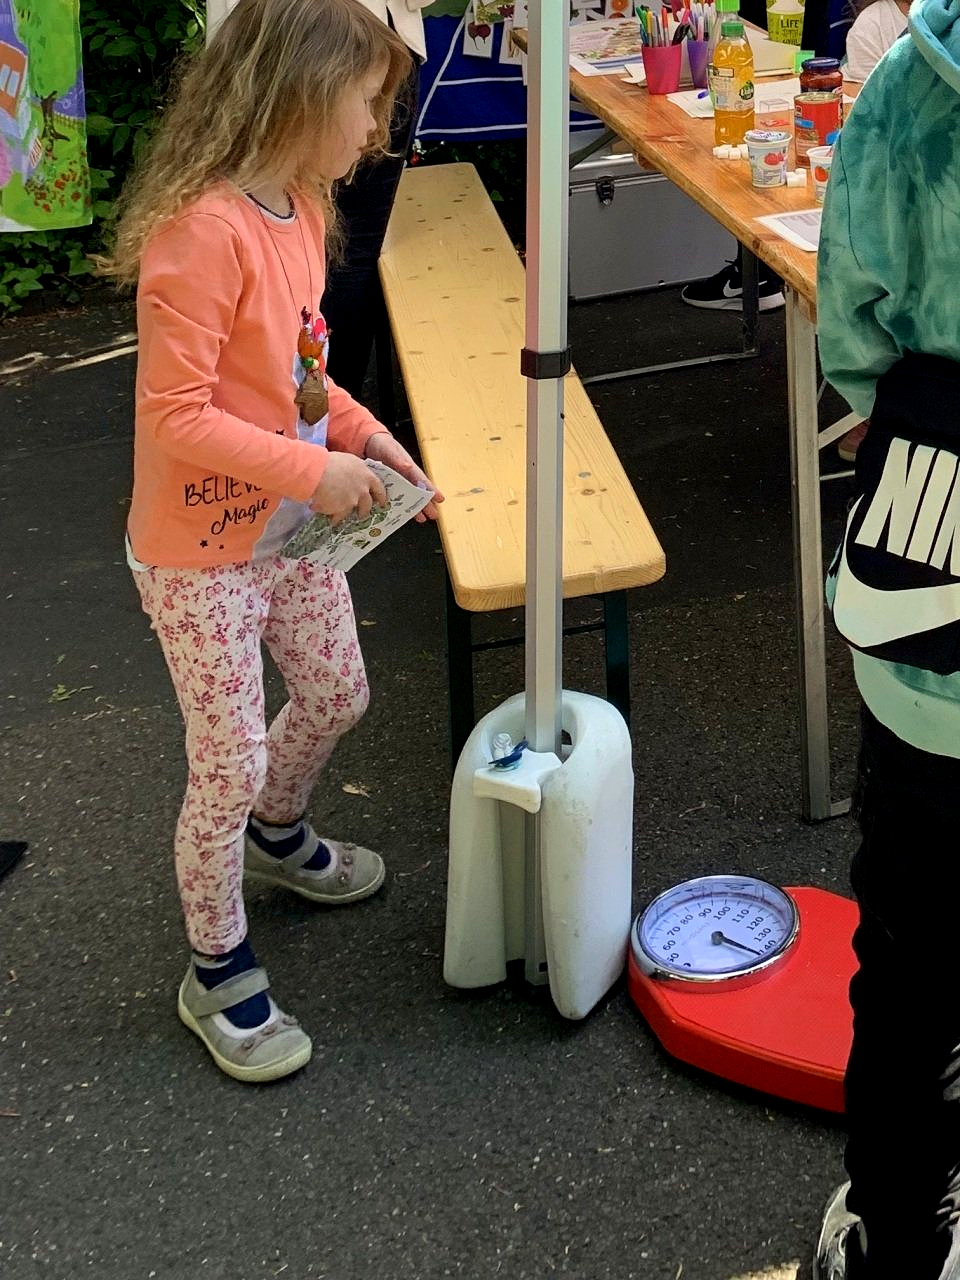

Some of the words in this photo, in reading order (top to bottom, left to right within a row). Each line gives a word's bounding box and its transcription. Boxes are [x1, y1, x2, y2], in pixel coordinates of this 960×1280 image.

[780, 18, 799, 29] LIFE
[698, 907, 712, 918] 90
[713, 906, 731, 920] 100
[732, 908, 750, 923] 110
[680, 914, 693, 926] 80
[746, 916, 765, 931] 120
[667, 926, 681, 937] 70
[753, 927, 772, 943] 130
[662, 940, 676, 951] 60
